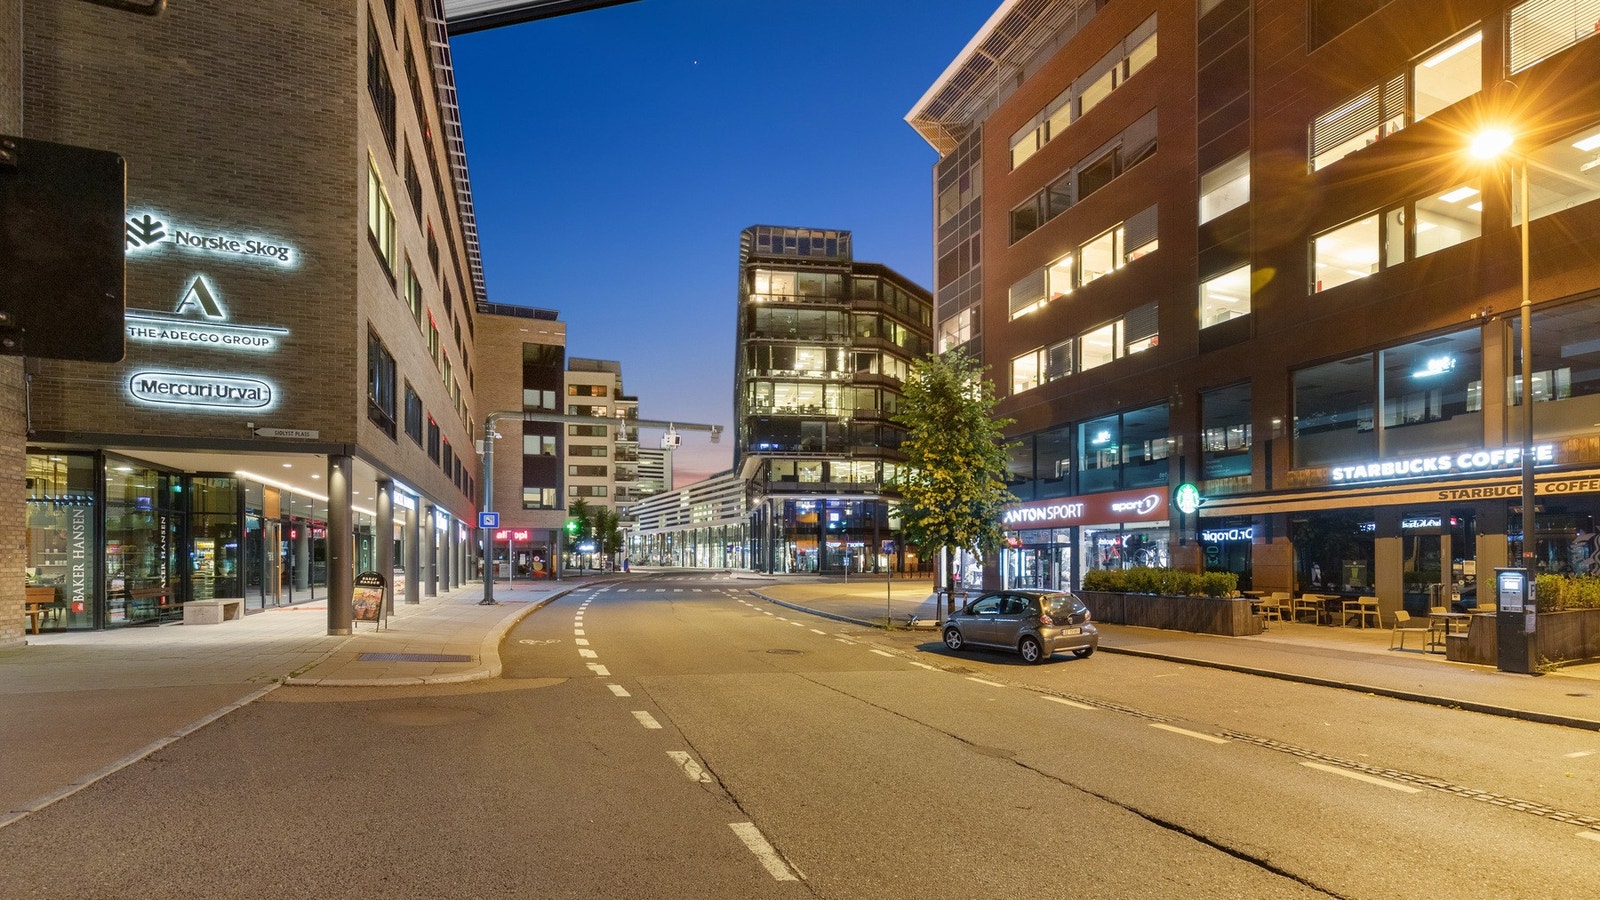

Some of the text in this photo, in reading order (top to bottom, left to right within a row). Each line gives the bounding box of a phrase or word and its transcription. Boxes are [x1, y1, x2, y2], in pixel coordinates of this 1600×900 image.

[175, 230, 290, 262] Norske Skog
[128, 327, 270, 347] THE ADECCO GROUP
[141, 379, 262, 400] Mercuri Urval
[1332, 445, 1553, 481] STARBUCKS COFFE
[1438, 486, 1538, 500] STARBUC
[496, 530, 528, 540] allopi
[73, 508, 85, 602] BAKER HANSEN
